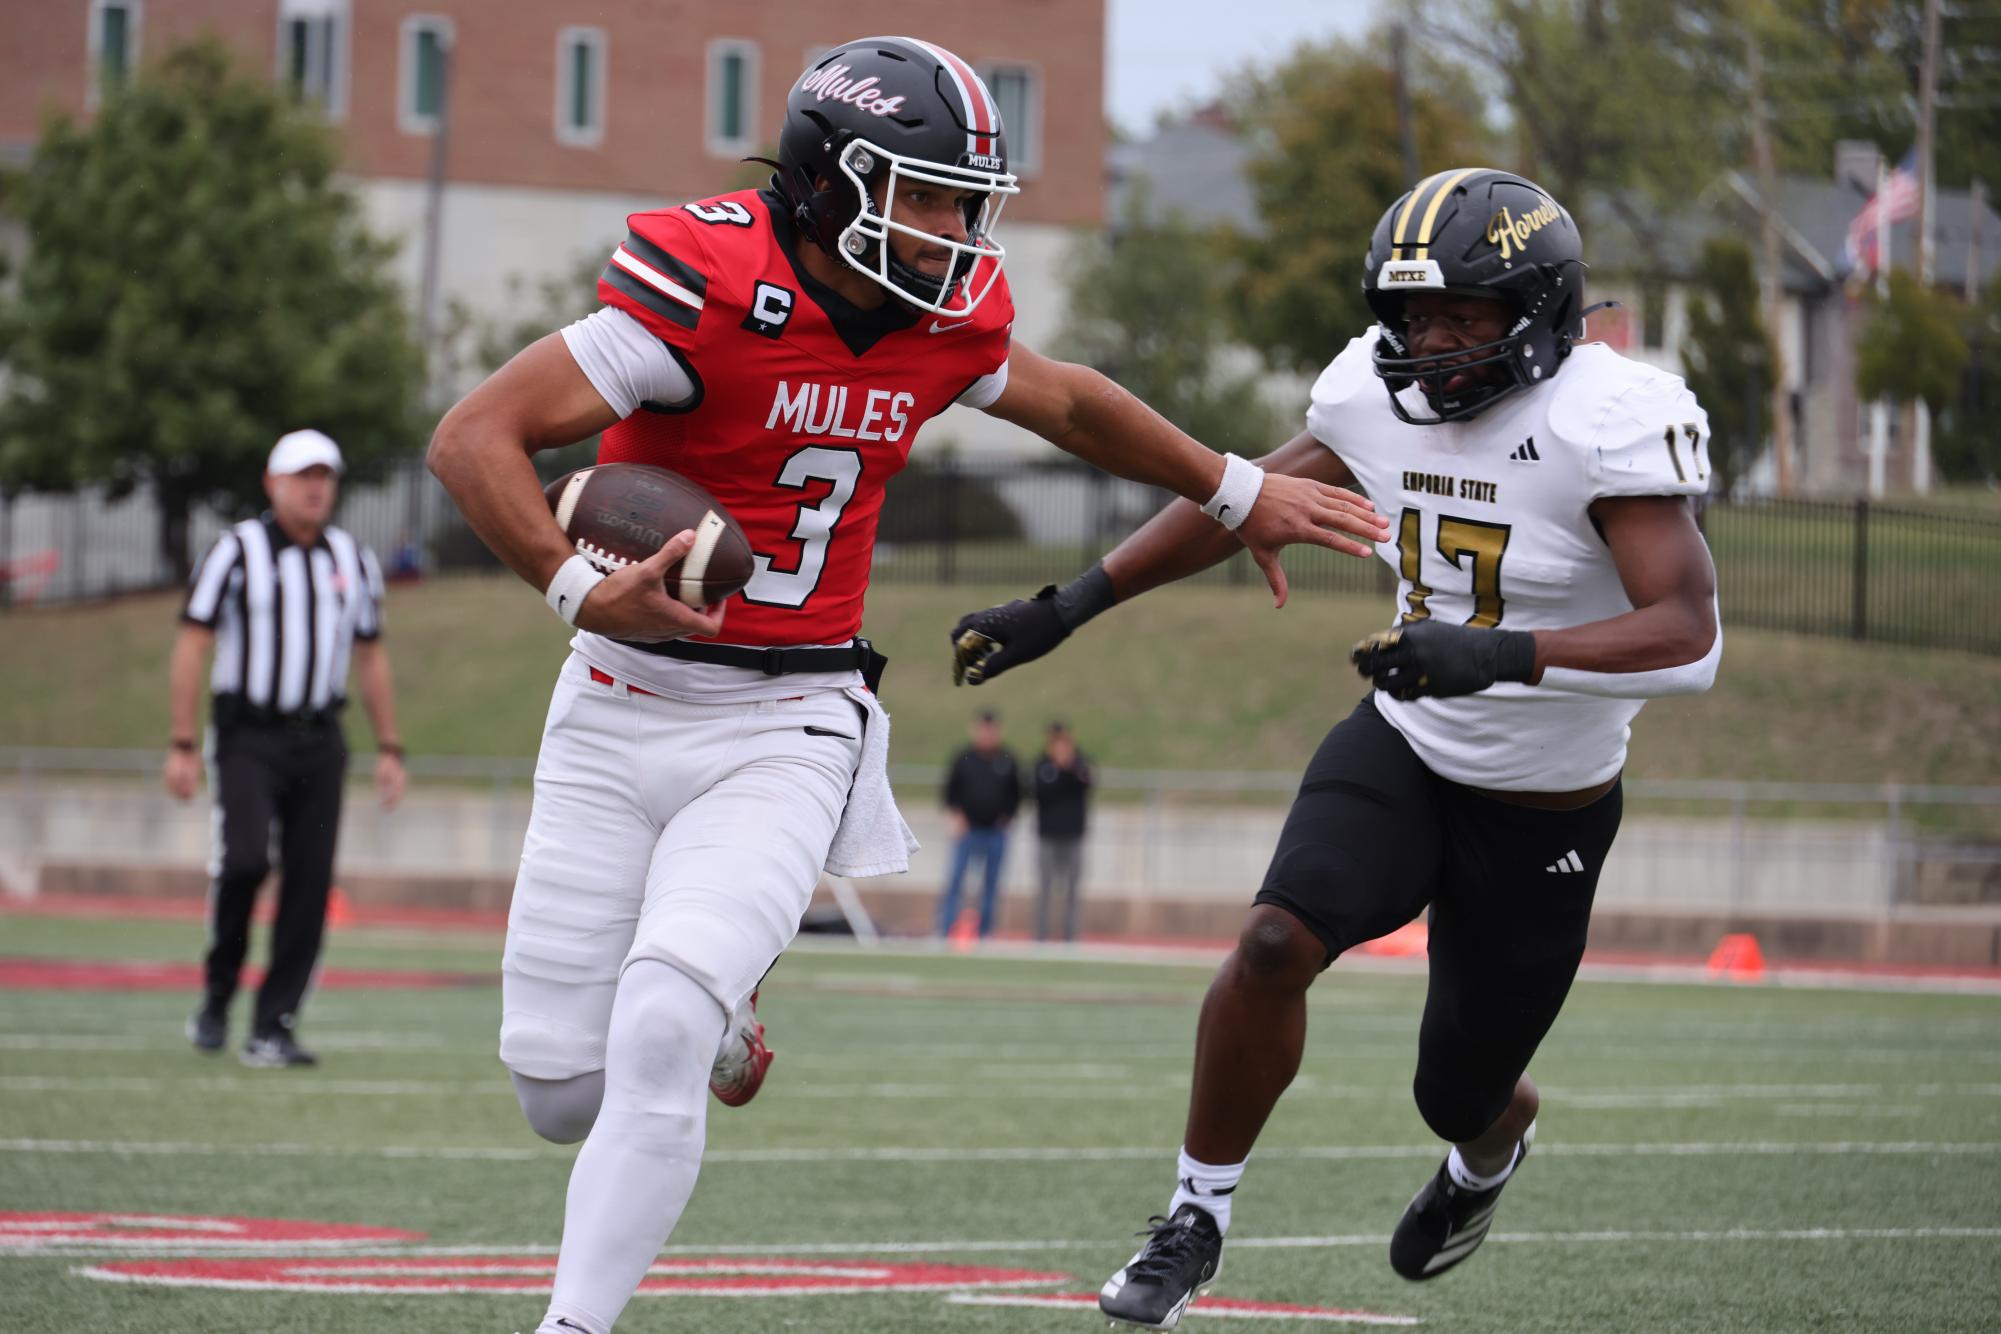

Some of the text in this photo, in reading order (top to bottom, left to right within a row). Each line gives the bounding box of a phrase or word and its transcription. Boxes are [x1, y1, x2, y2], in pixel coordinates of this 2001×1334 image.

[801, 64, 906, 117] Mules
[968, 154, 1001, 170] MULES
[681, 201, 756, 228] 3
[1388, 269, 1427, 282] MTXE
[752, 284, 792, 326] C
[765, 381, 915, 442] MULES
[1664, 422, 1705, 484] 17
[1403, 471, 1497, 504] EMPORIA STATE
[741, 443, 864, 610] 3
[1396, 507, 1512, 628] 17
